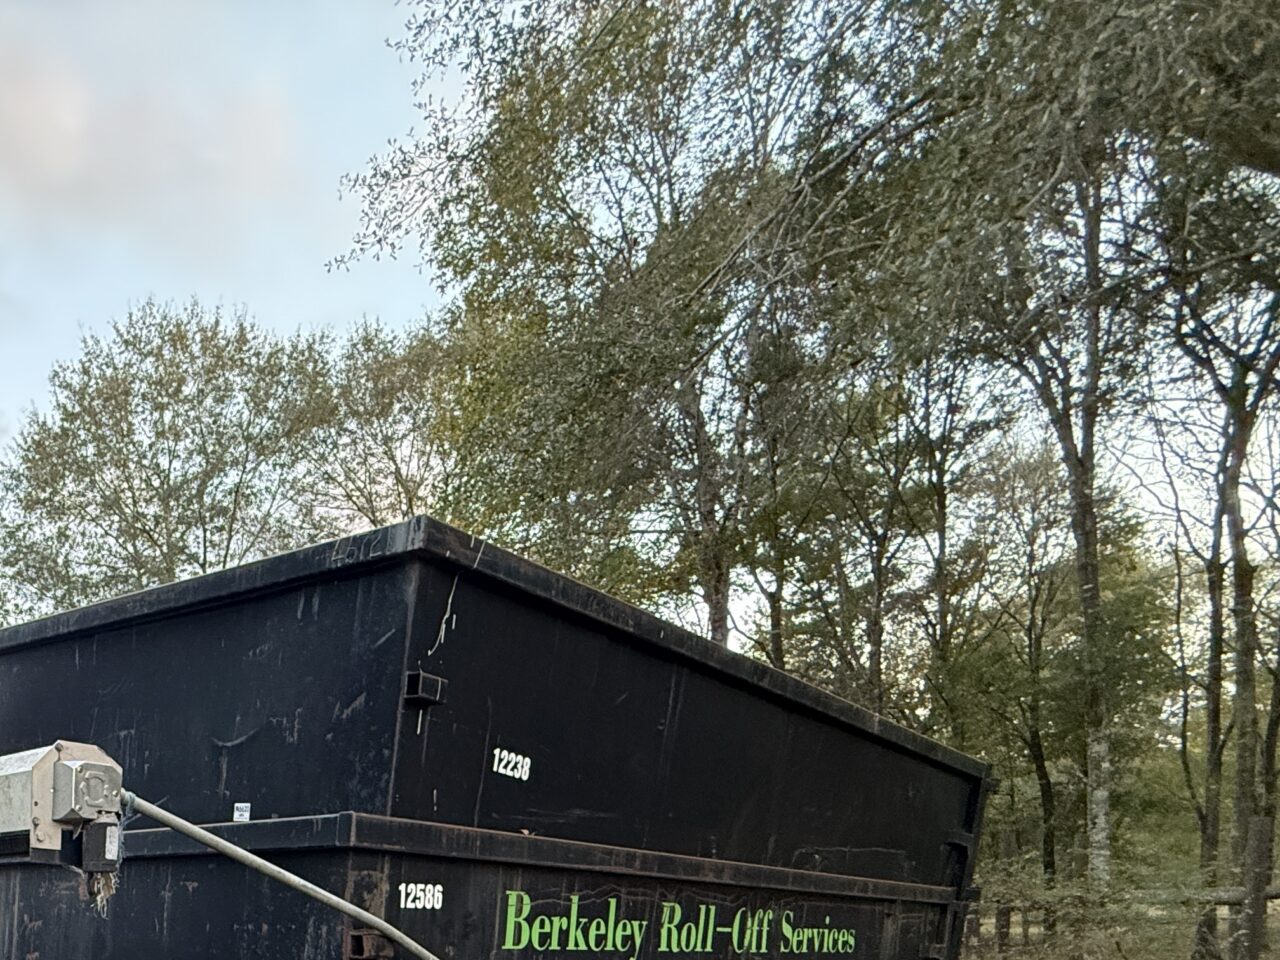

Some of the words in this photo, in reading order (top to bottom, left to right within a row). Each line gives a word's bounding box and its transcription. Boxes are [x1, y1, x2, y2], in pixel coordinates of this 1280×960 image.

[492, 747, 532, 781] 12238
[398, 882, 444, 910] 12586
[658, 901, 771, 953] Roll-Off
[780, 910, 856, 954] Services
